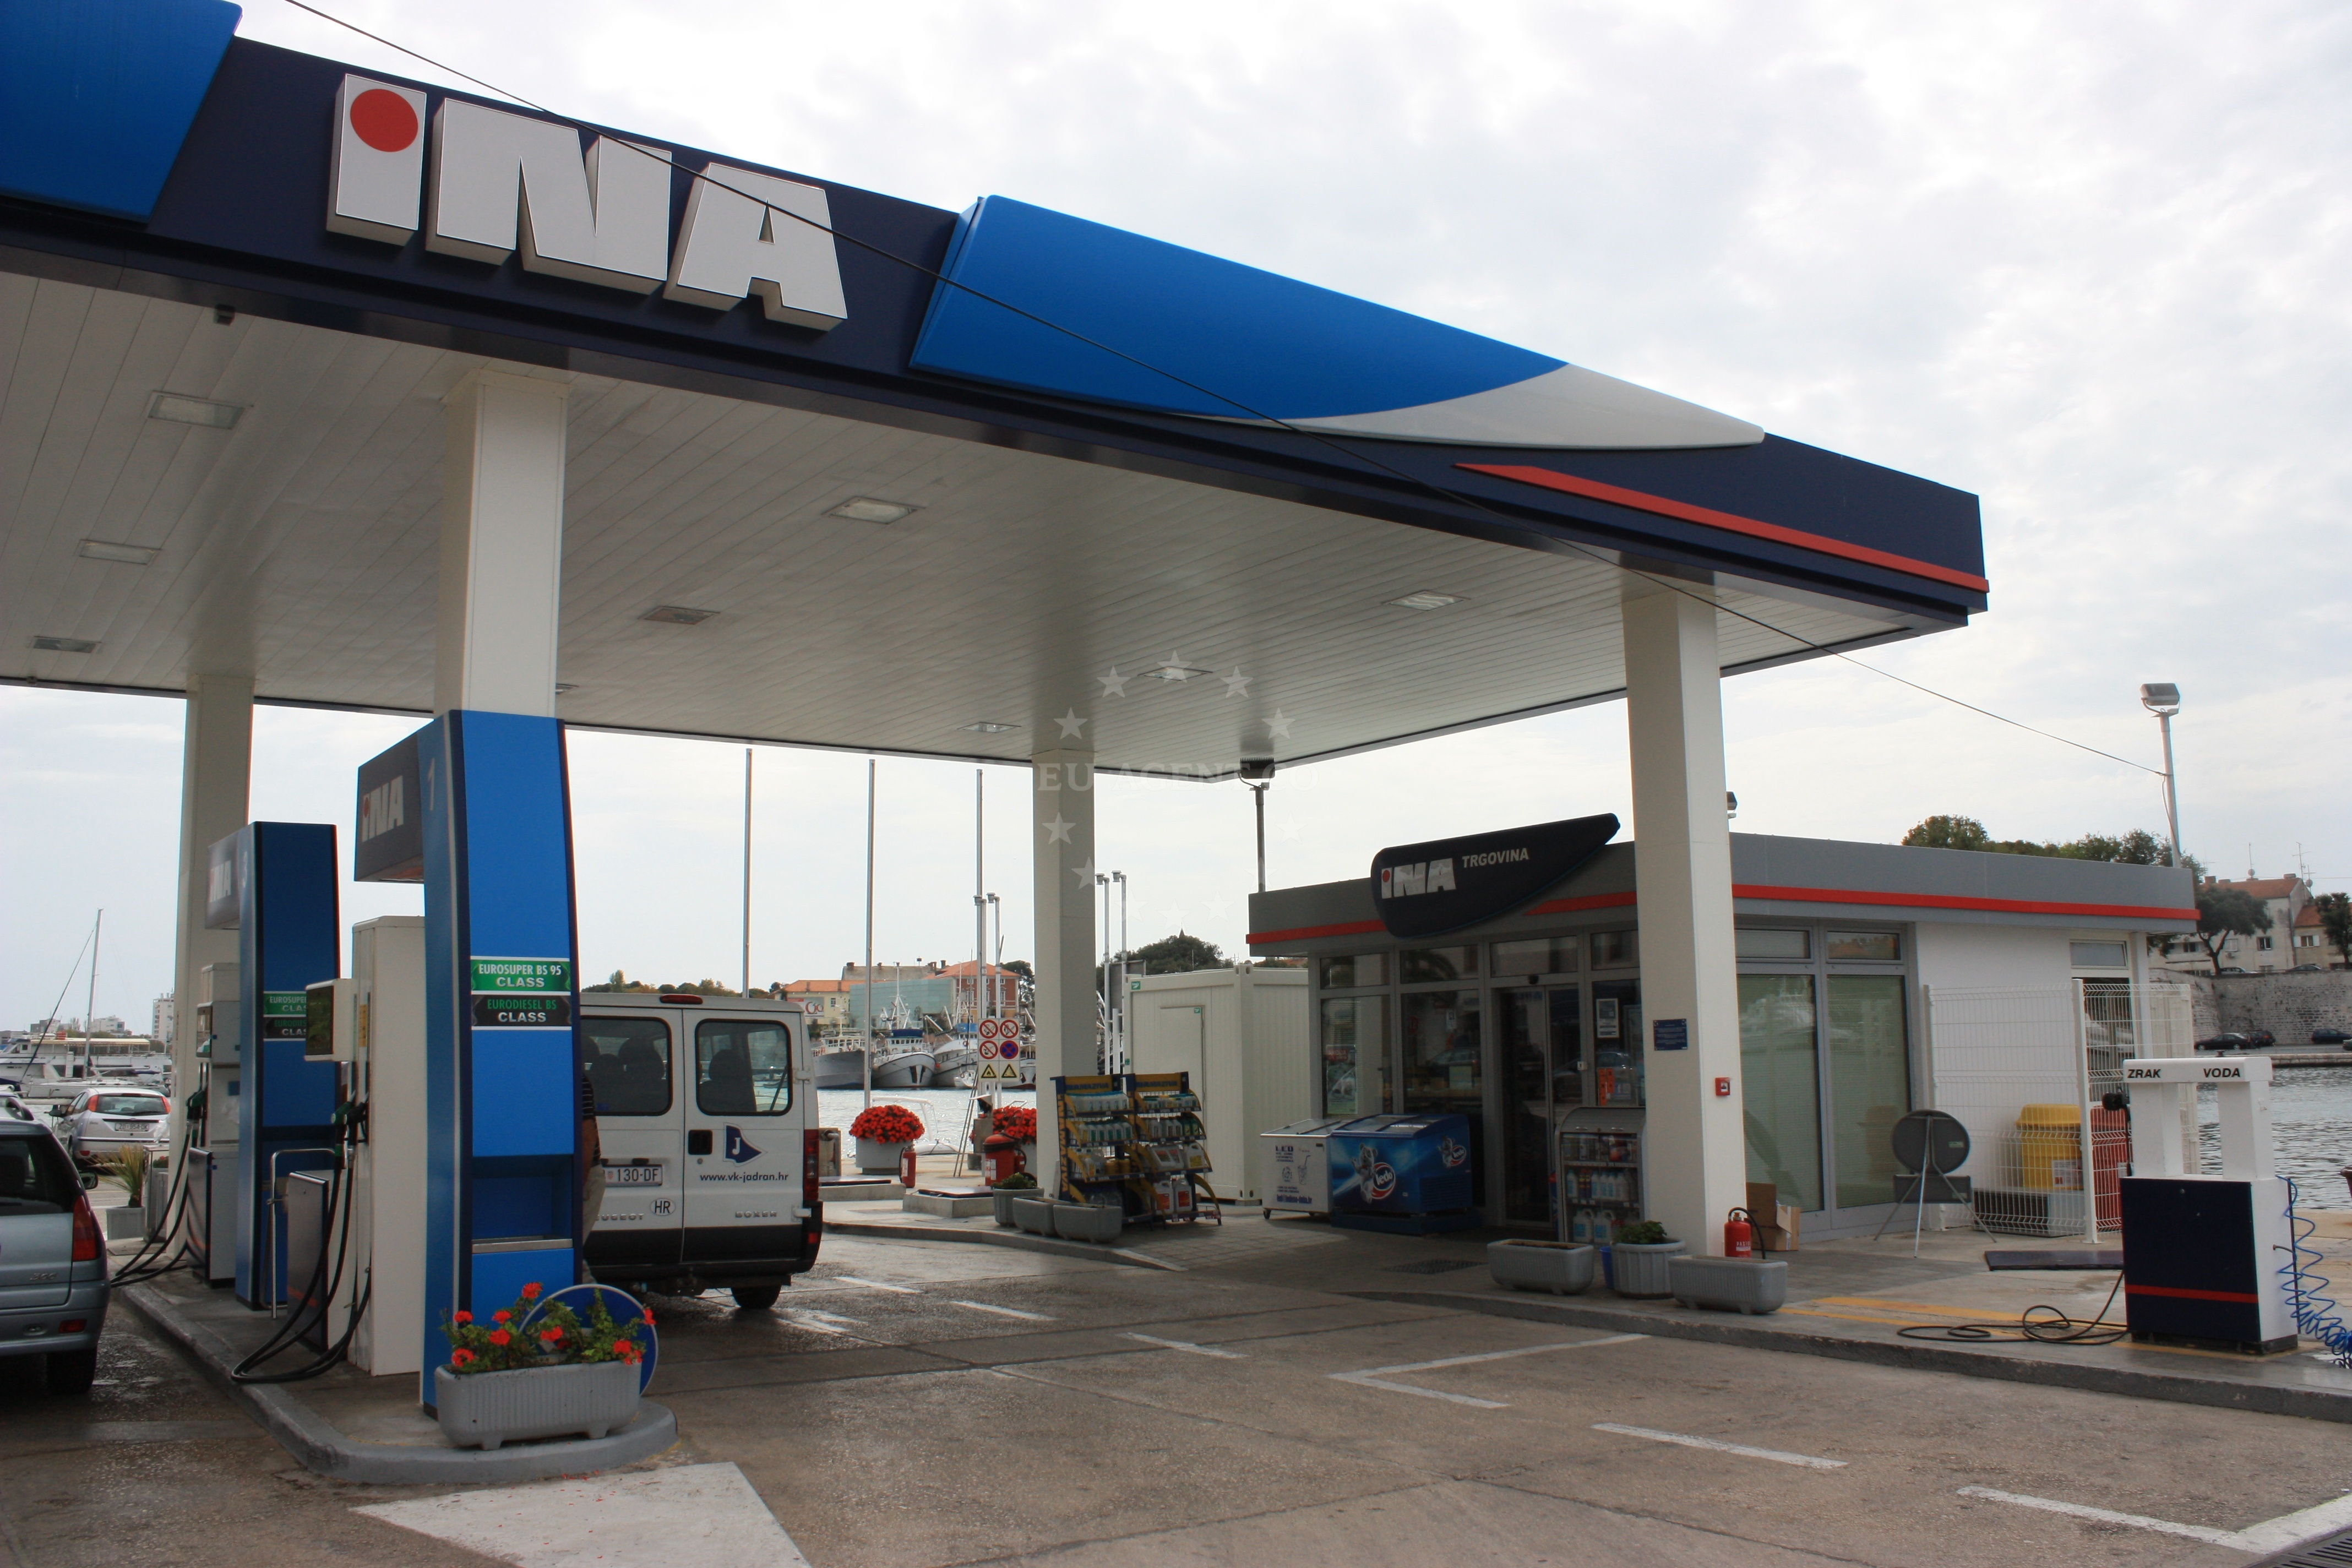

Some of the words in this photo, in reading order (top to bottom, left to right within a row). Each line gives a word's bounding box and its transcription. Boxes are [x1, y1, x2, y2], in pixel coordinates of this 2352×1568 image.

[327, 73, 848, 331] INA
[427, 758, 435, 812] 1
[362, 775, 404, 842] INA
[1381, 858, 1456, 899] INA
[1462, 848, 1529, 868] TRGOVINA
[478, 964, 533, 974] EUROSUPER
[537, 965, 548, 975] BS
[551, 965, 562, 975] 95
[497, 977, 545, 987] CLASS
[487, 999, 542, 1009] EURODIESEL
[546, 1000, 557, 1010] BS
[498, 1012, 547, 1022] CLASS
[2127, 1069, 2161, 1078] ZRAK
[2203, 1068, 2240, 1077] VODA
[732, 1137, 741, 1155] J
[618, 1168, 659, 1182] 130-DF
[700, 1172, 789, 1183] www.vk-jadran.hr
[1375, 1170, 1393, 1185] ledo
[655, 1201, 670, 1214] HR
